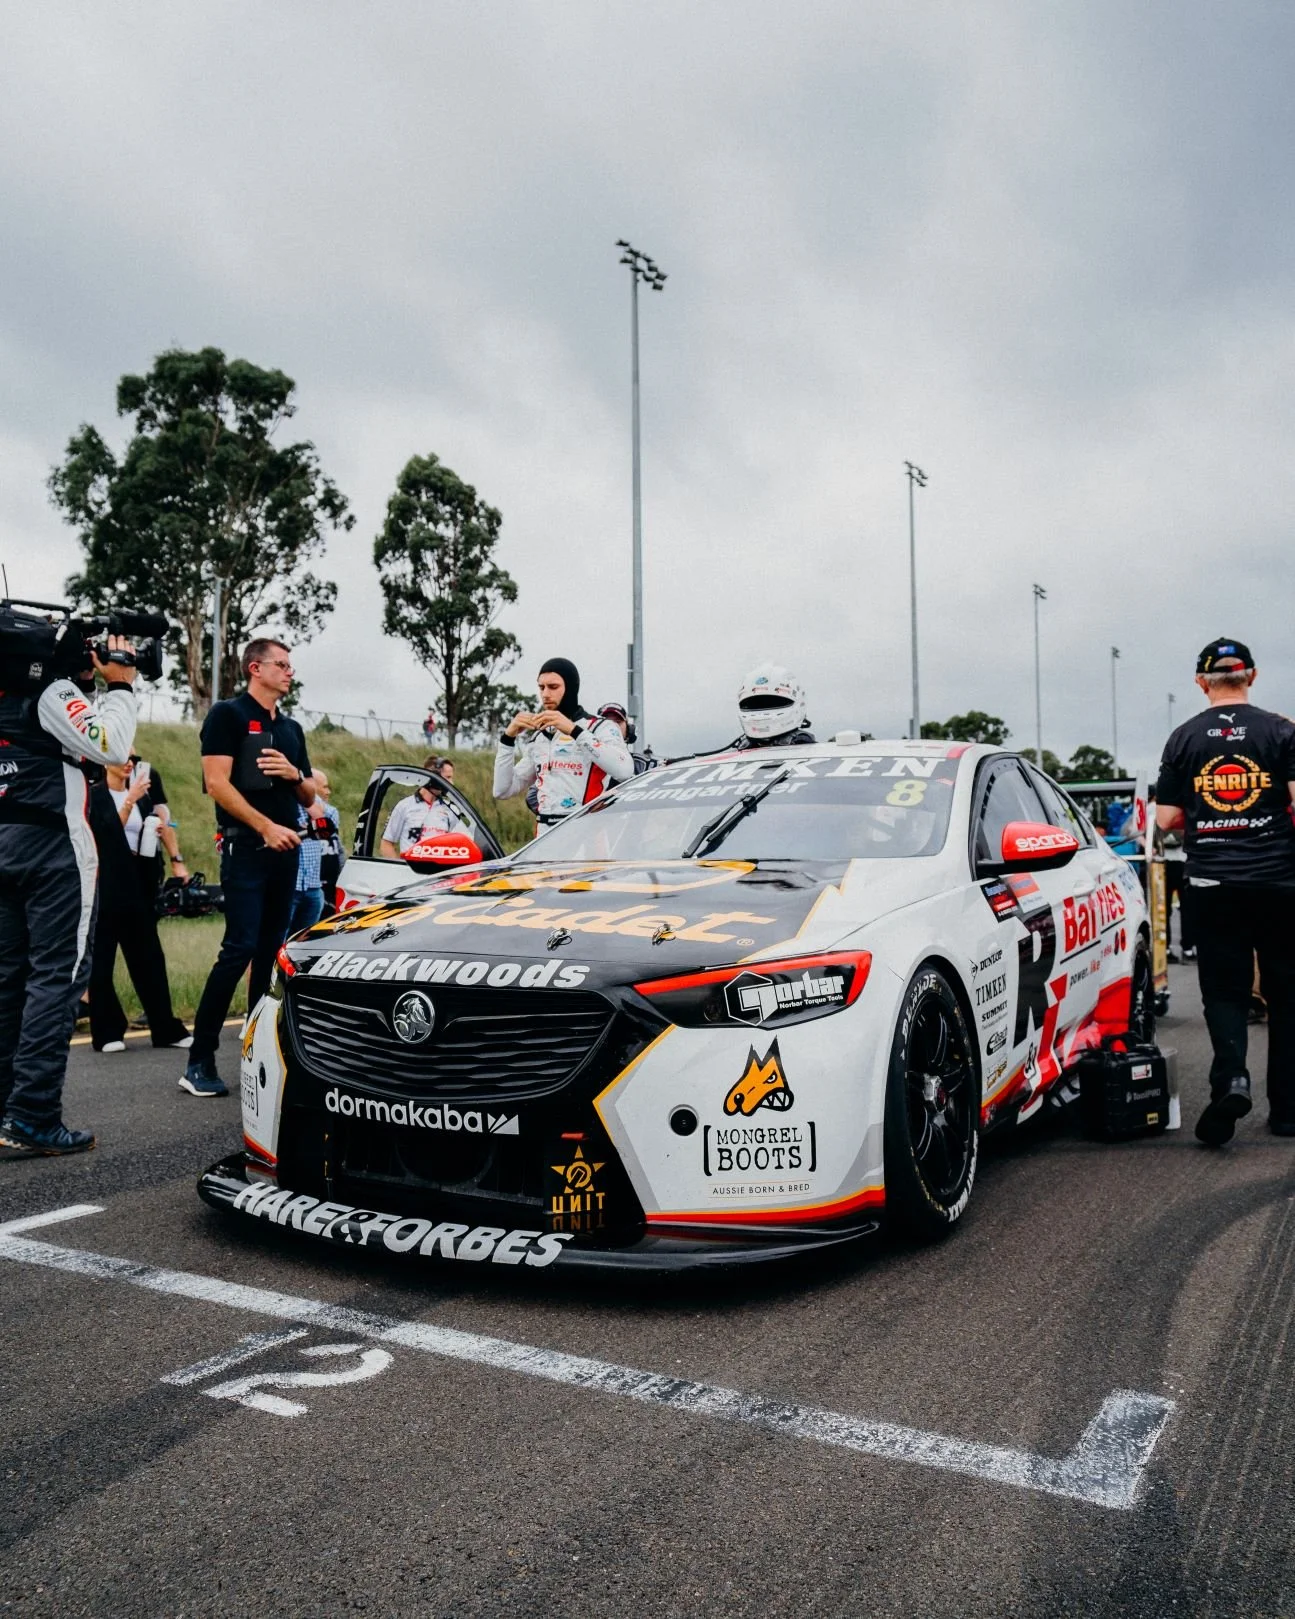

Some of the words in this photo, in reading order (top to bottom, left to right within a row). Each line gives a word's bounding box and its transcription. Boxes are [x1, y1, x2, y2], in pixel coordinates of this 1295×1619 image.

[1207, 727, 1246, 737] GROVE
[542, 761, 583, 770] Btteries
[625, 756, 947, 791] TIMKEN
[885, 780, 928, 806] 8
[1194, 772, 1273, 793] PENRITE
[1196, 818, 1249, 829] RACING
[411, 845, 470, 859] sparco
[1015, 832, 1077, 852] sparco
[433, 897, 777, 944] Cadet
[308, 950, 591, 989] Blackwoods
[980, 949, 1003, 971] DUNLOP
[976, 973, 1007, 1007] TIMKEN
[779, 1001, 803, 1010] Norbar
[804, 997, 827, 1006] Torque
[325, 1088, 484, 1134] dormakaba
[717, 1127, 803, 1145] MONGREL
[717, 1146, 802, 1171] BOOTS
[712, 1186, 745, 1195] AUSSIE
[748, 1185, 775, 1194] BORN
[778, 1185, 785, 1193] &
[788, 1183, 810, 1192] BRED
